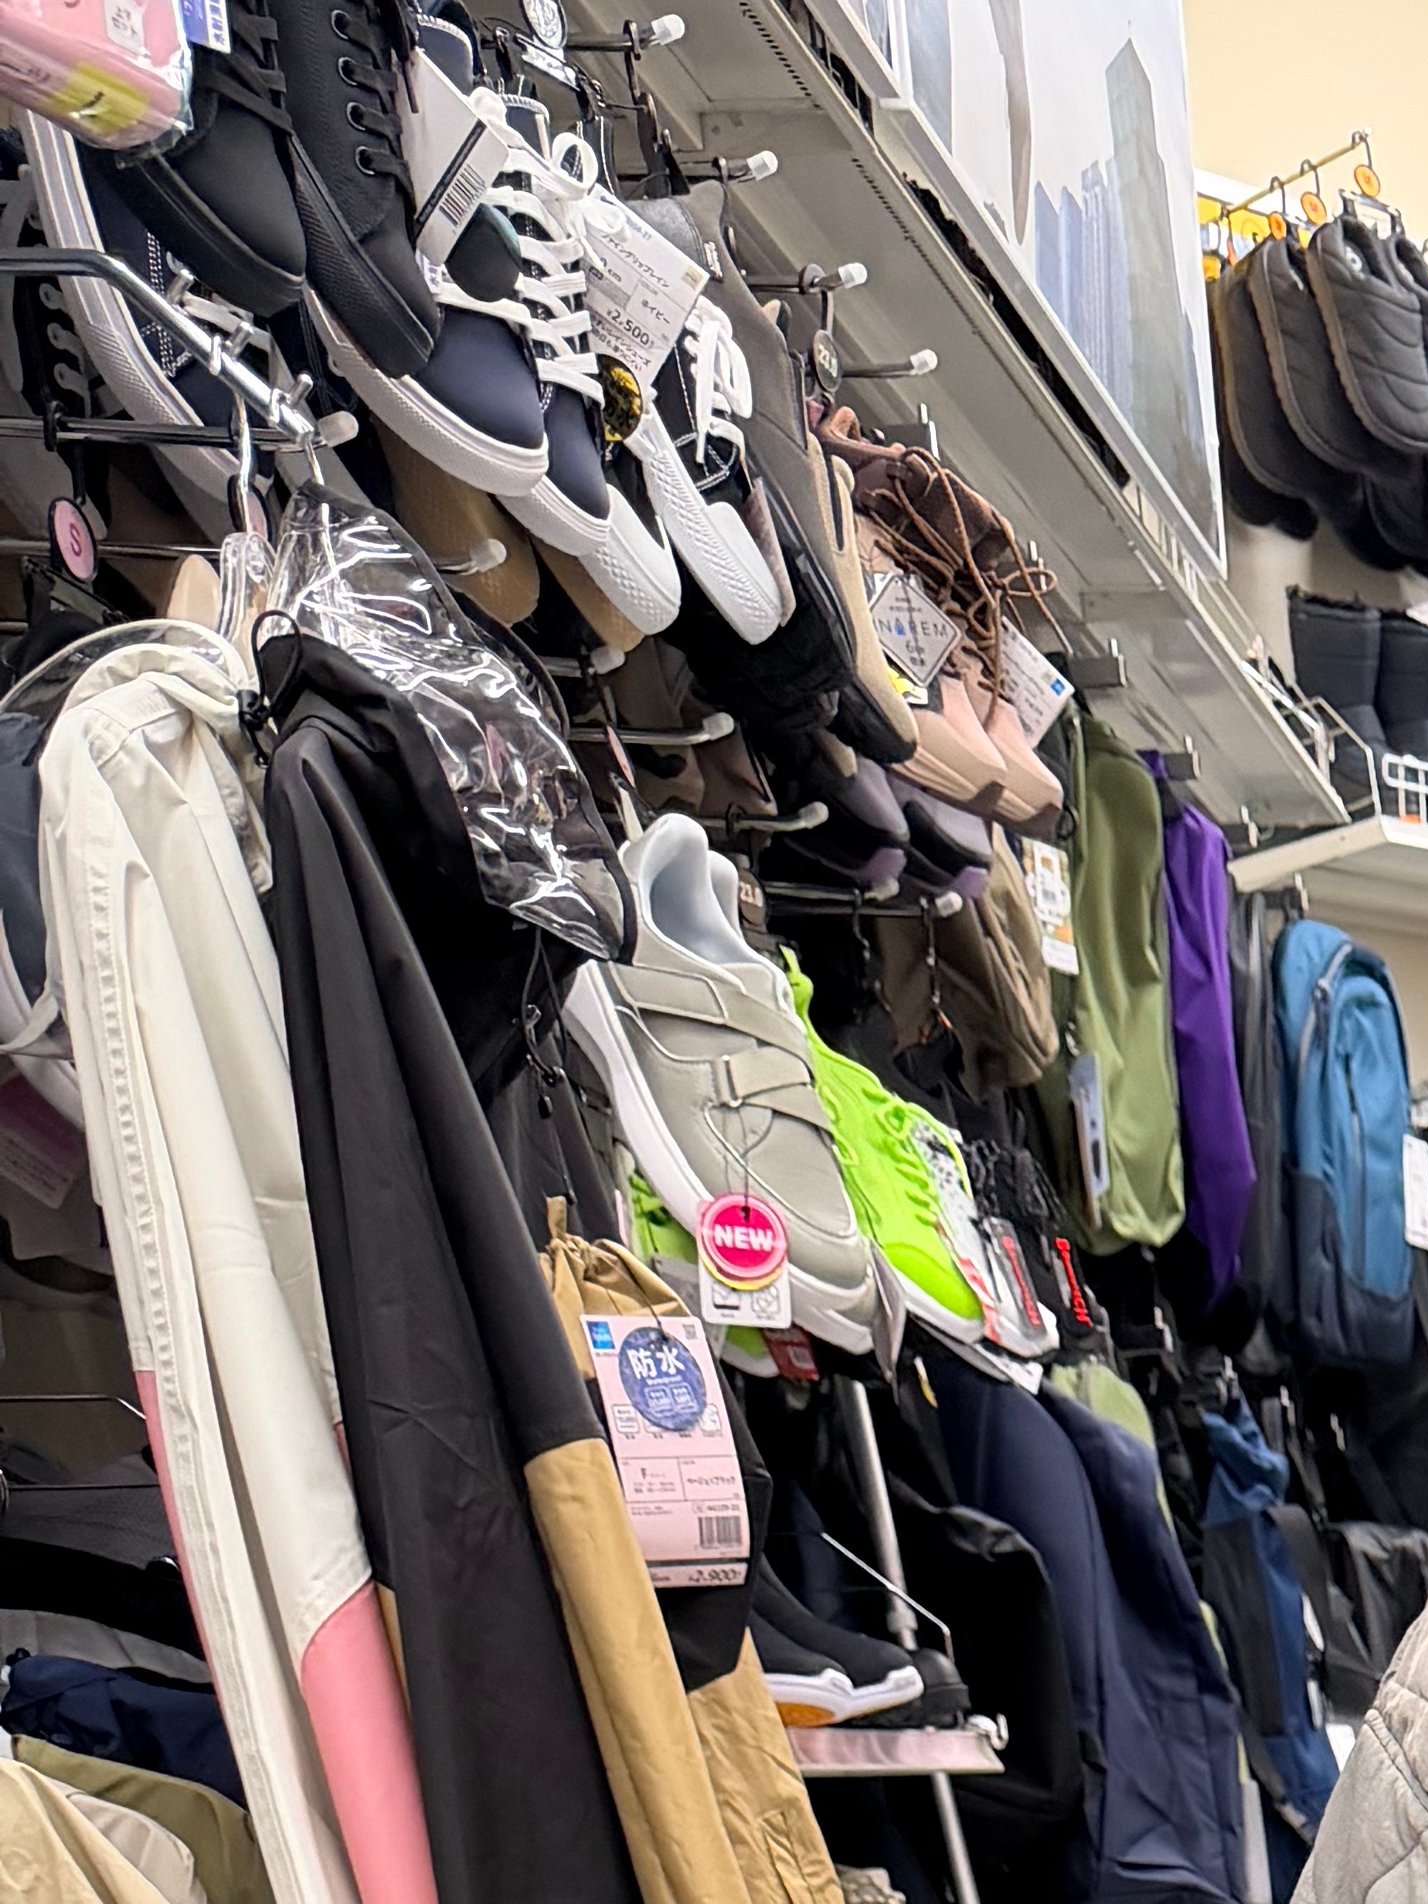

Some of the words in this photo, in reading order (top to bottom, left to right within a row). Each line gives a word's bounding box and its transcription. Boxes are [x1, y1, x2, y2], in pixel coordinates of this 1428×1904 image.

[69, 522, 82, 557] S
[714, 1223, 773, 1252] NEW
[627, 1345, 686, 1380] 防水
